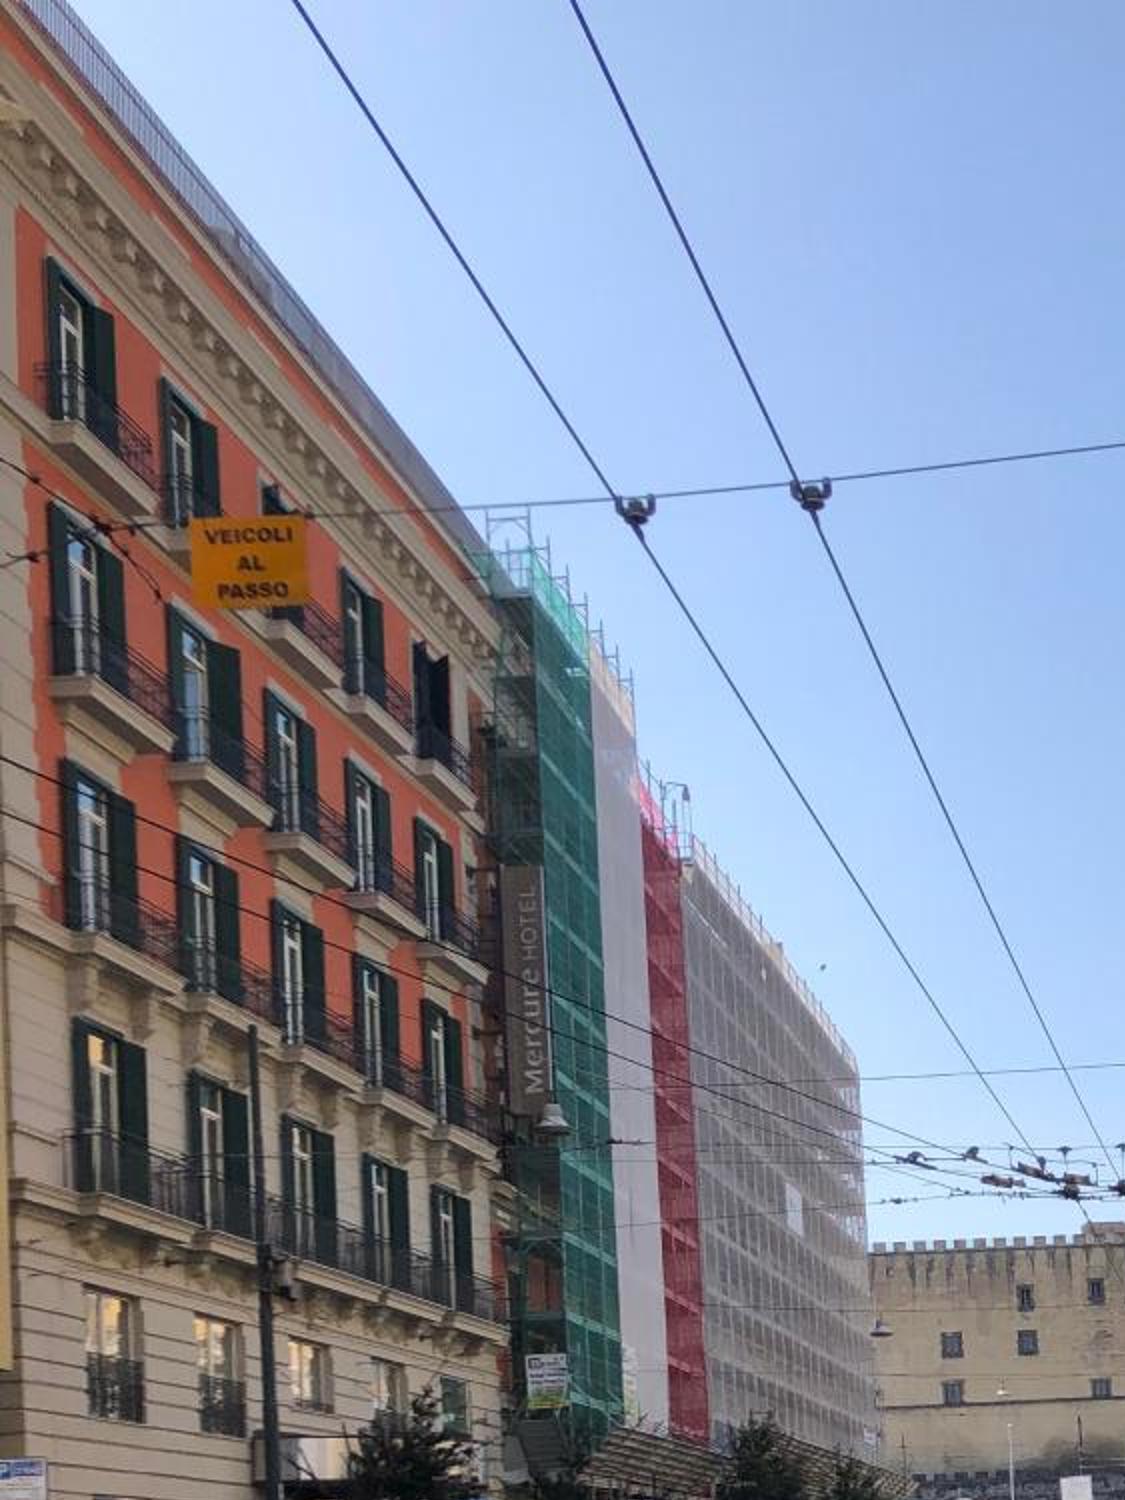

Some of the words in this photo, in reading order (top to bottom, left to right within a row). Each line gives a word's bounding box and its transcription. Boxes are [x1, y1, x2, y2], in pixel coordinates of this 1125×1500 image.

[204, 526, 293, 544] VEICOLI
[238, 554, 266, 572] AL
[217, 582, 289, 600] PASSO
[518, 884, 539, 960] HOTEL
[523, 968, 545, 1095] Mercure
